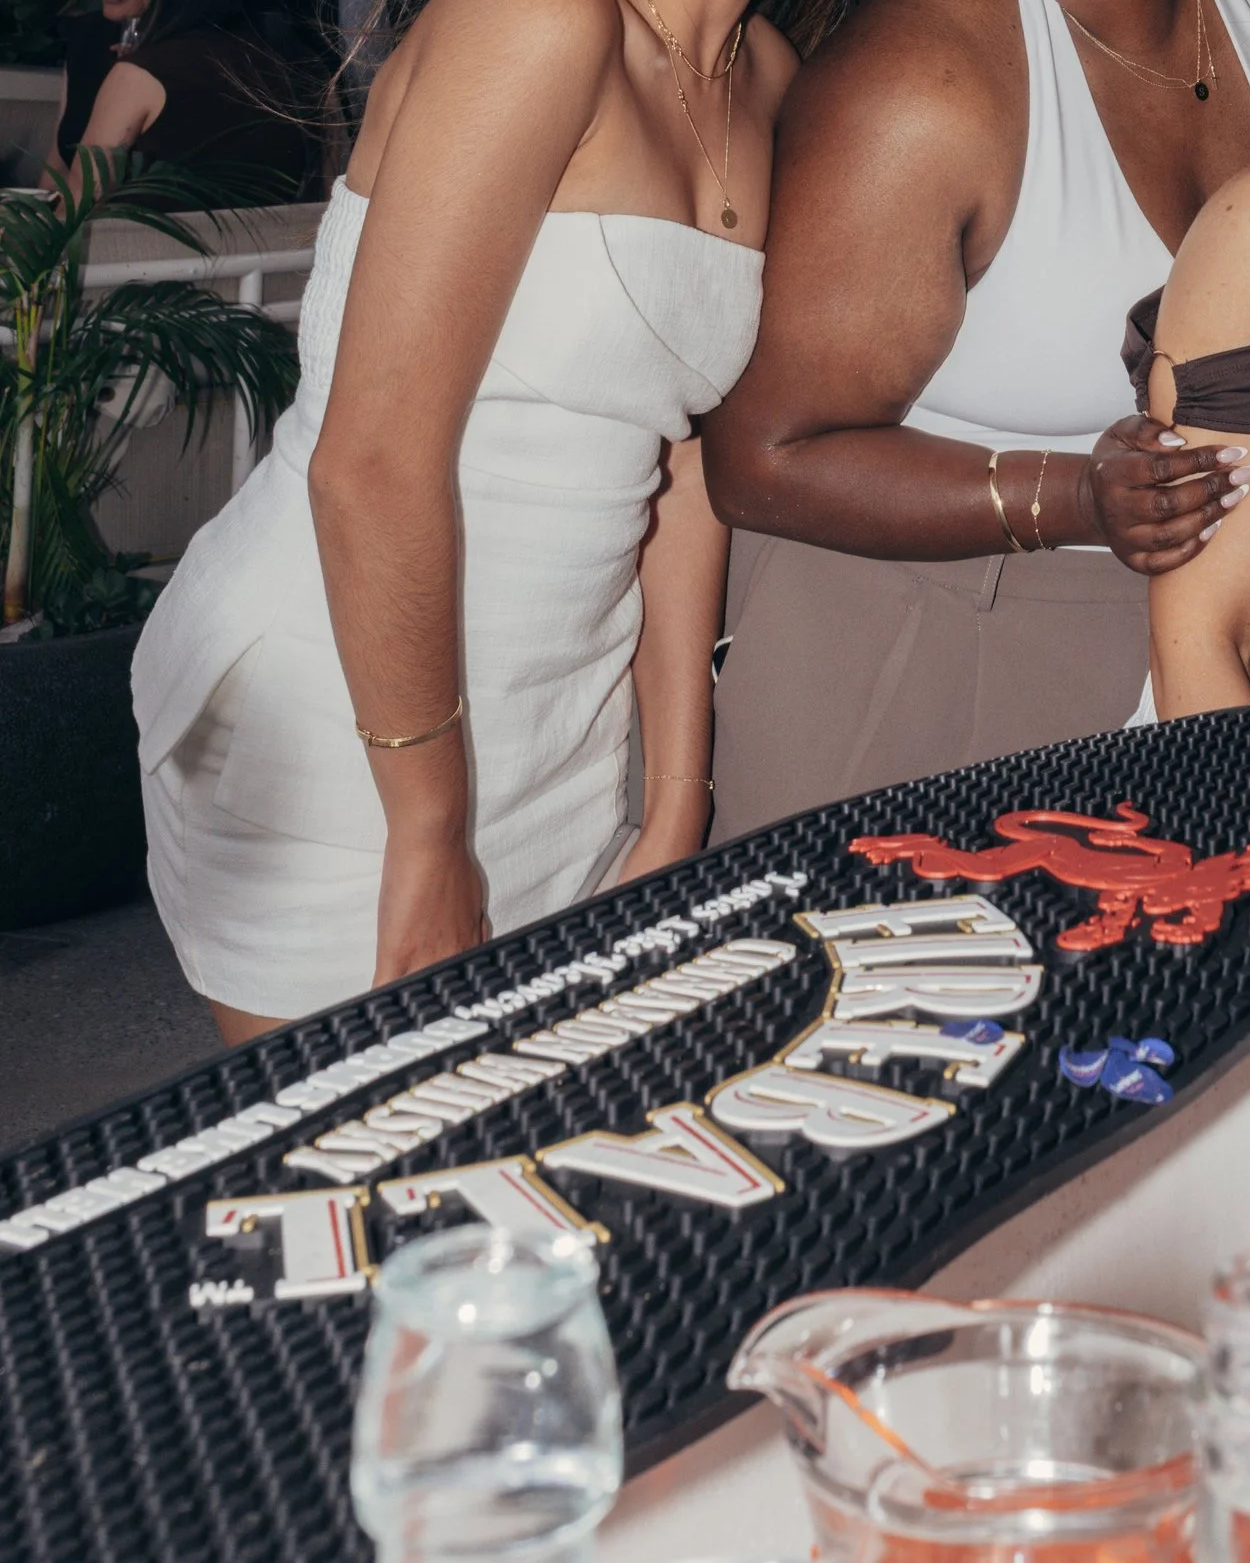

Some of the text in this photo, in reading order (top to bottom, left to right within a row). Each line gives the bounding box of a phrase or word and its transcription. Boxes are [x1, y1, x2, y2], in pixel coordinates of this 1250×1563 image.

[692, 871, 809, 922] Tastes
[613, 915, 700, 957] Like
[207, 893, 1046, 1301] FIREBALL
[275, 1016, 490, 1111] BURNS
[283, 938, 797, 1184] CINNAMON WHISKY
[137, 1101, 303, 1179] LIKE
[189, 1277, 255, 1308] TM
